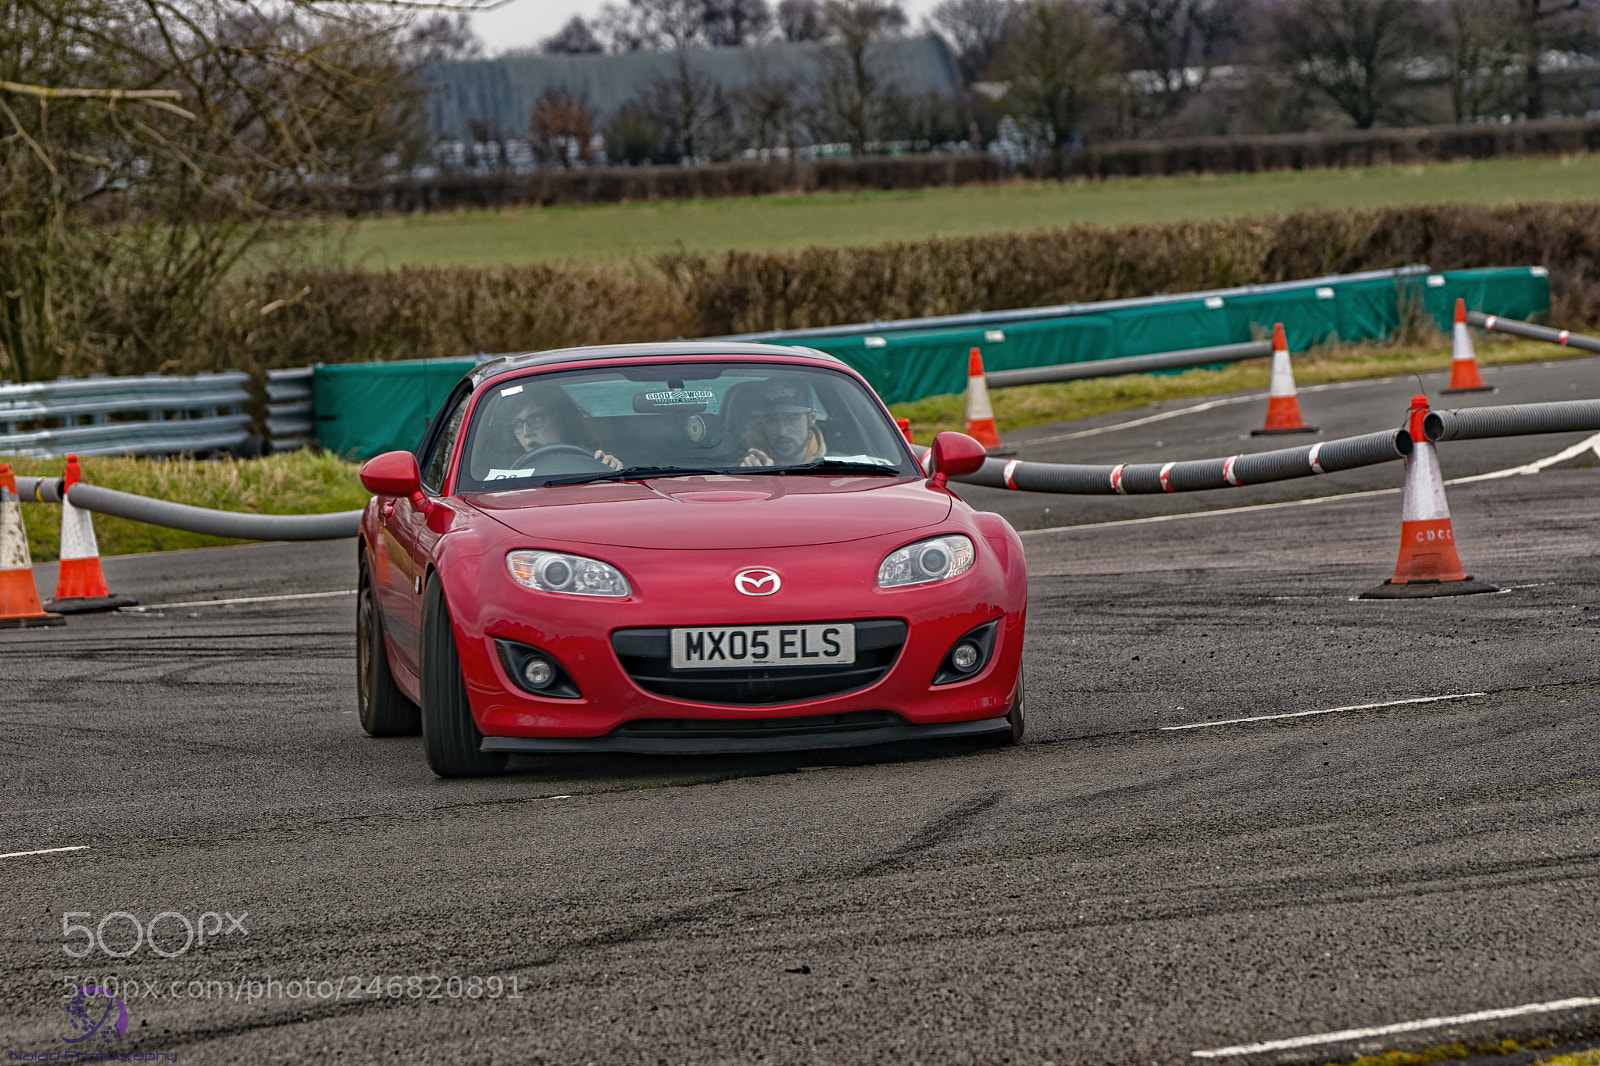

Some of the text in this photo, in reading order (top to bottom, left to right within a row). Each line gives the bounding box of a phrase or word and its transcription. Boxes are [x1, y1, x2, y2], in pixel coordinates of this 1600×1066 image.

[647, 392, 671, 400] GOOD
[685, 628, 842, 661] MX05 ELS
